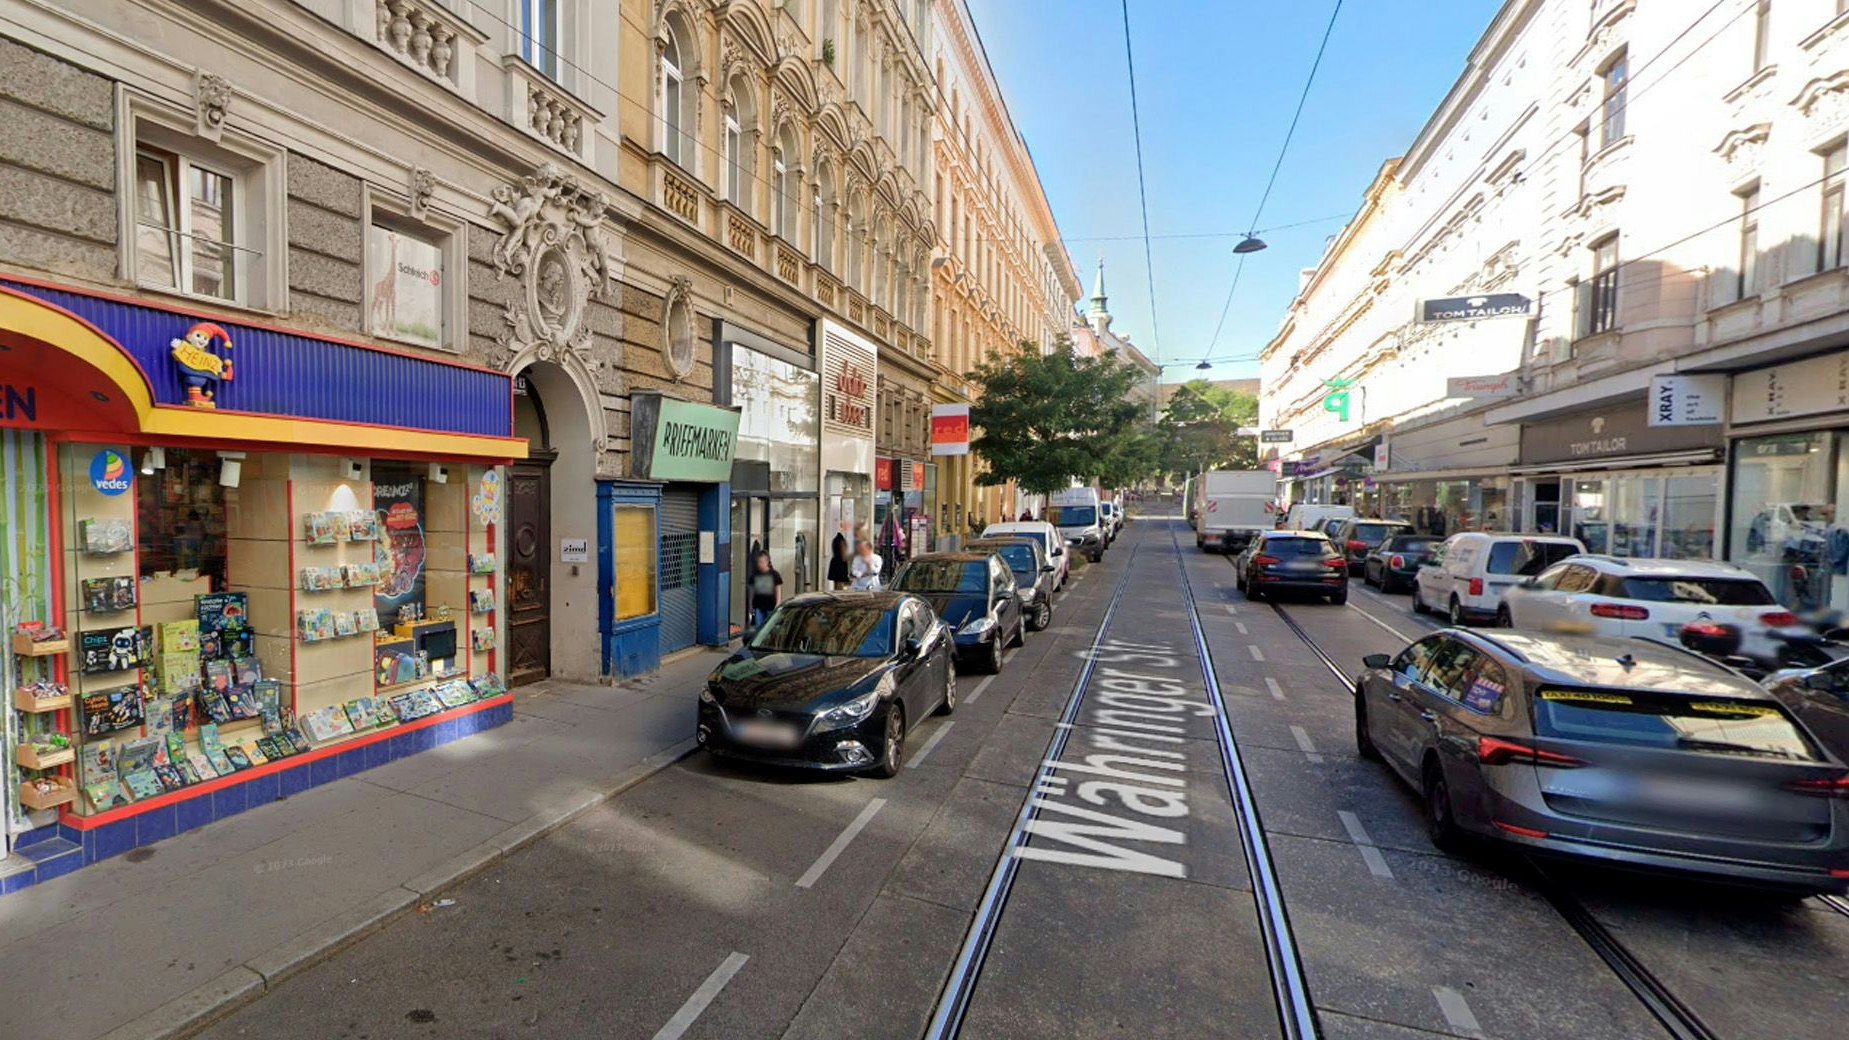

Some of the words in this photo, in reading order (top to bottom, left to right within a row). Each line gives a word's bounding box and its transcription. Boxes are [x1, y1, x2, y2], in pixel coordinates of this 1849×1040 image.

[180, 346, 221, 371] HEINZ
[0, 384, 36, 421] N
[935, 420, 965, 434] red
[96, 478, 128, 490] vedes
